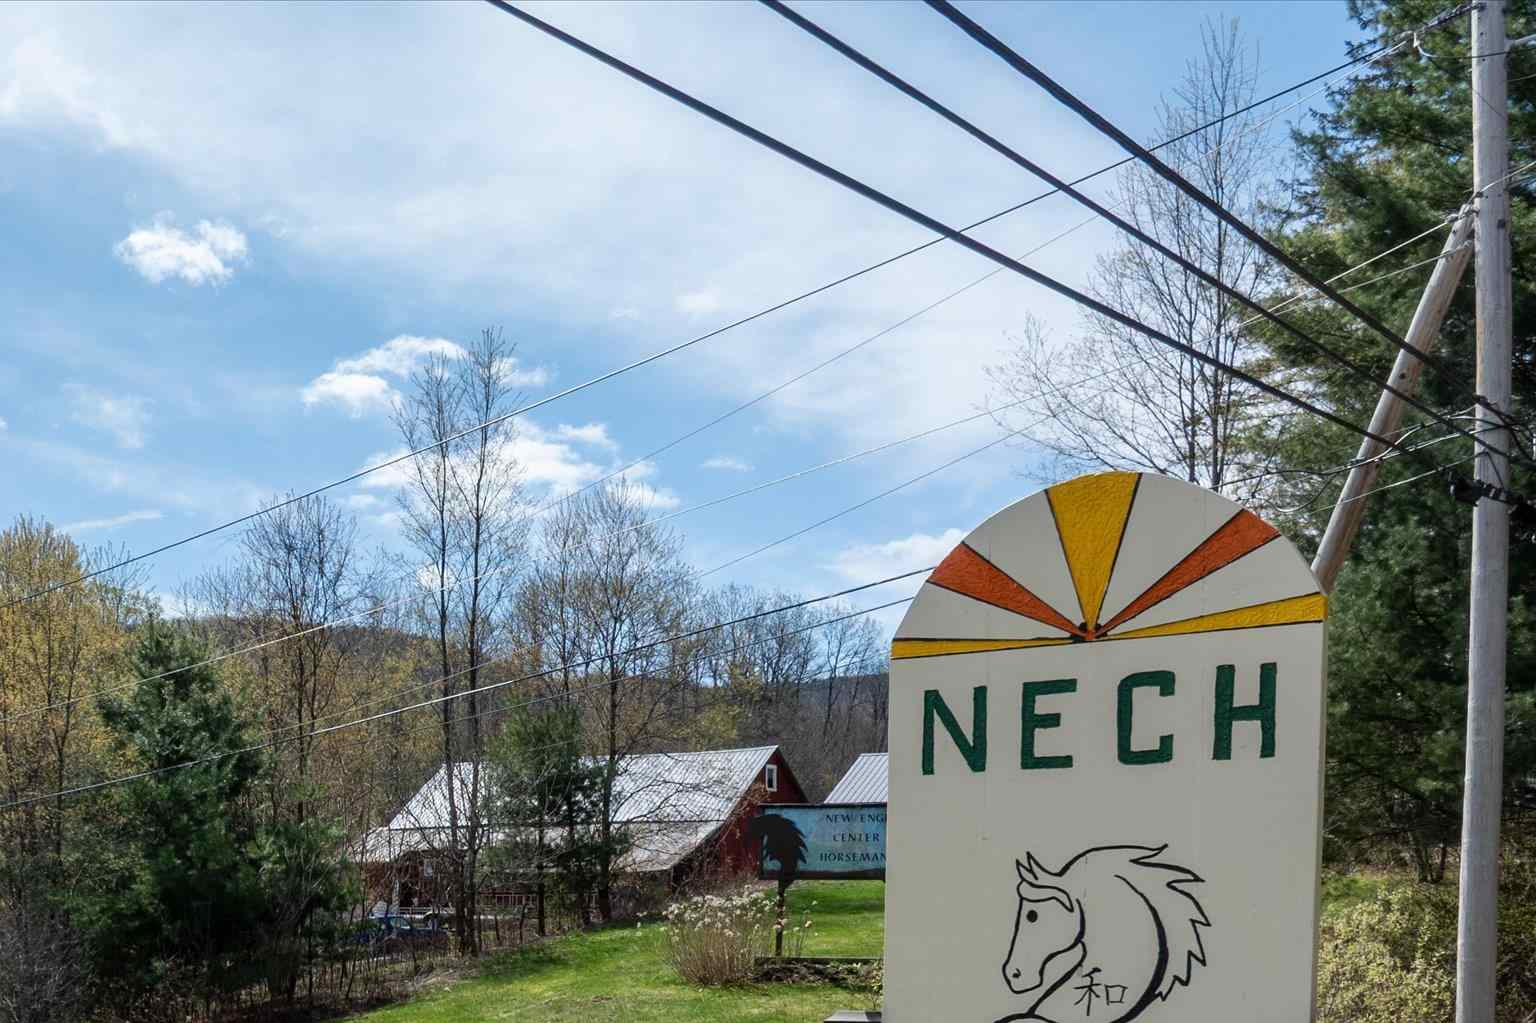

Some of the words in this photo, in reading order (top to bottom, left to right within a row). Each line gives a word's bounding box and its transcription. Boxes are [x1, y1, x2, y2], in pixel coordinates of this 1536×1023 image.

[921, 661, 1278, 776] NECH
[825, 813, 851, 824] NEW
[832, 831, 880, 842] CENTER
[1072, 966, 1128, 1017] 和
